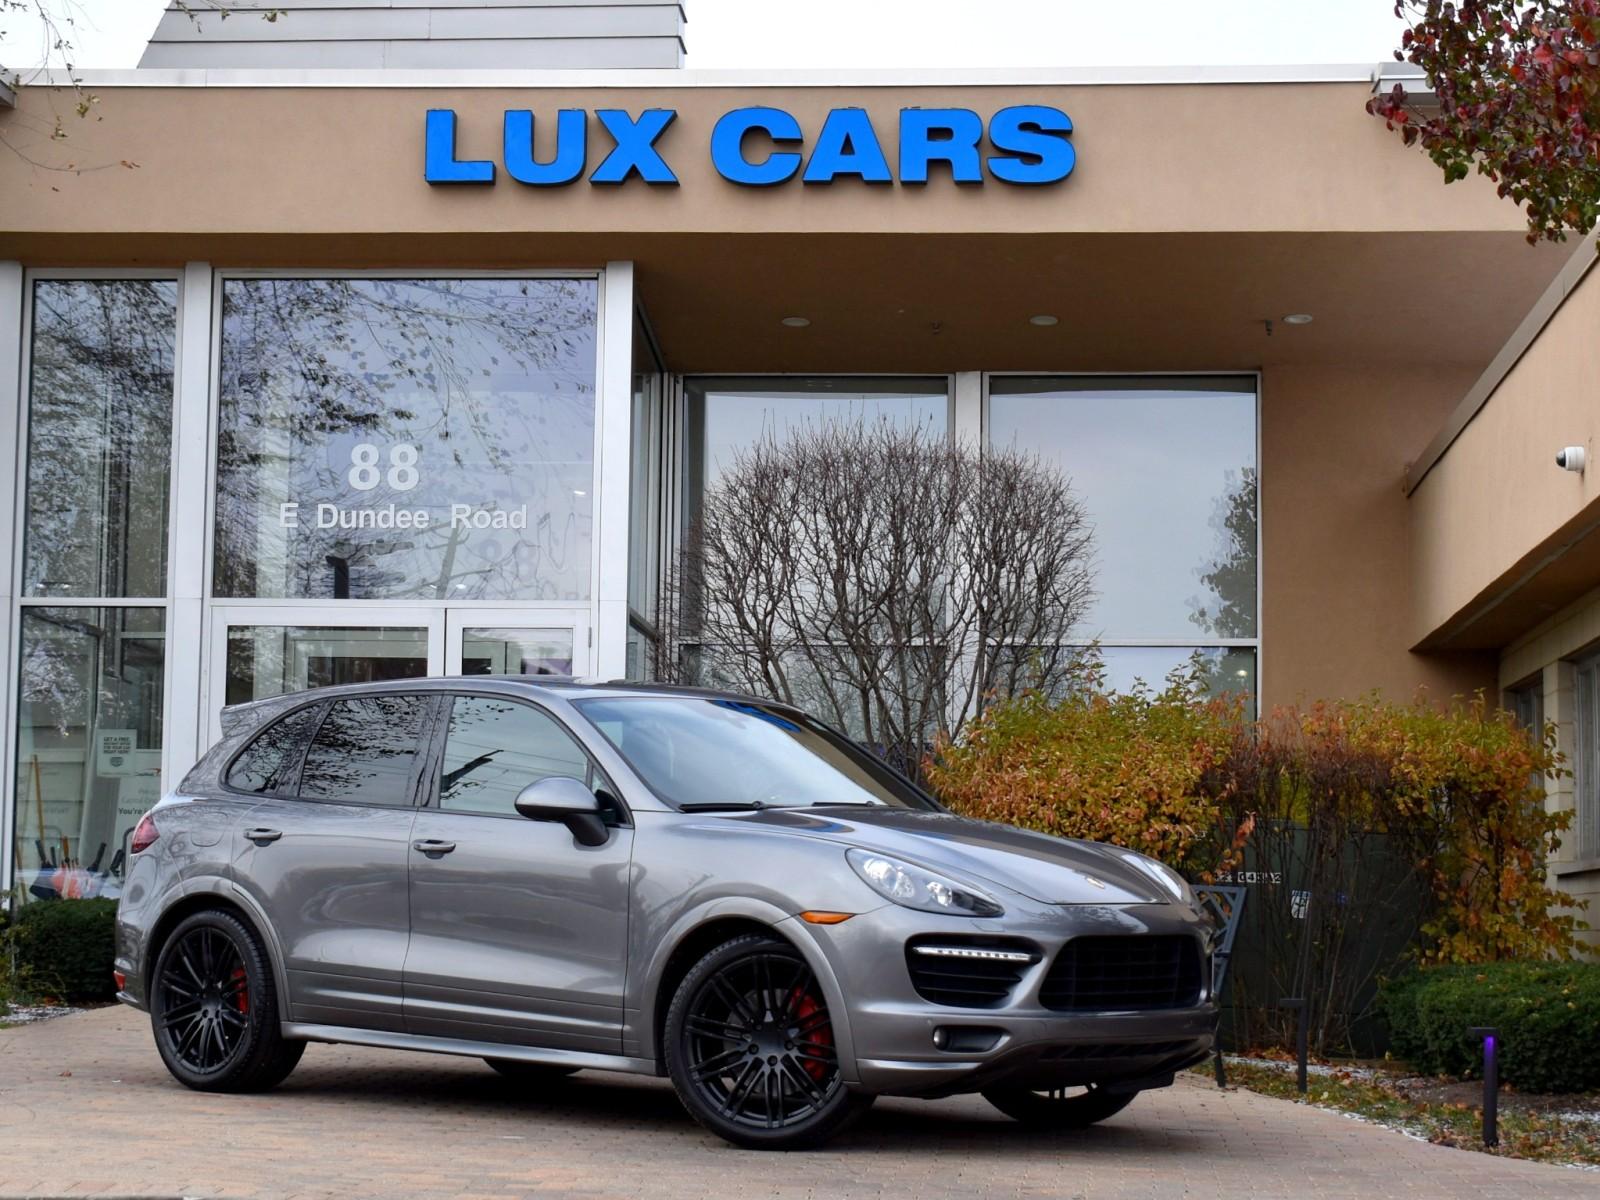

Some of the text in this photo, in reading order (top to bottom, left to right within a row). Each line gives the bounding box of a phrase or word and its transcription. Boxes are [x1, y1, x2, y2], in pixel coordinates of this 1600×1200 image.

[425, 105, 1076, 187] LUX CARS
[349, 443, 420, 491] 88
[279, 502, 528, 529] E Dundee Road
[118, 807, 143, 815] You're
